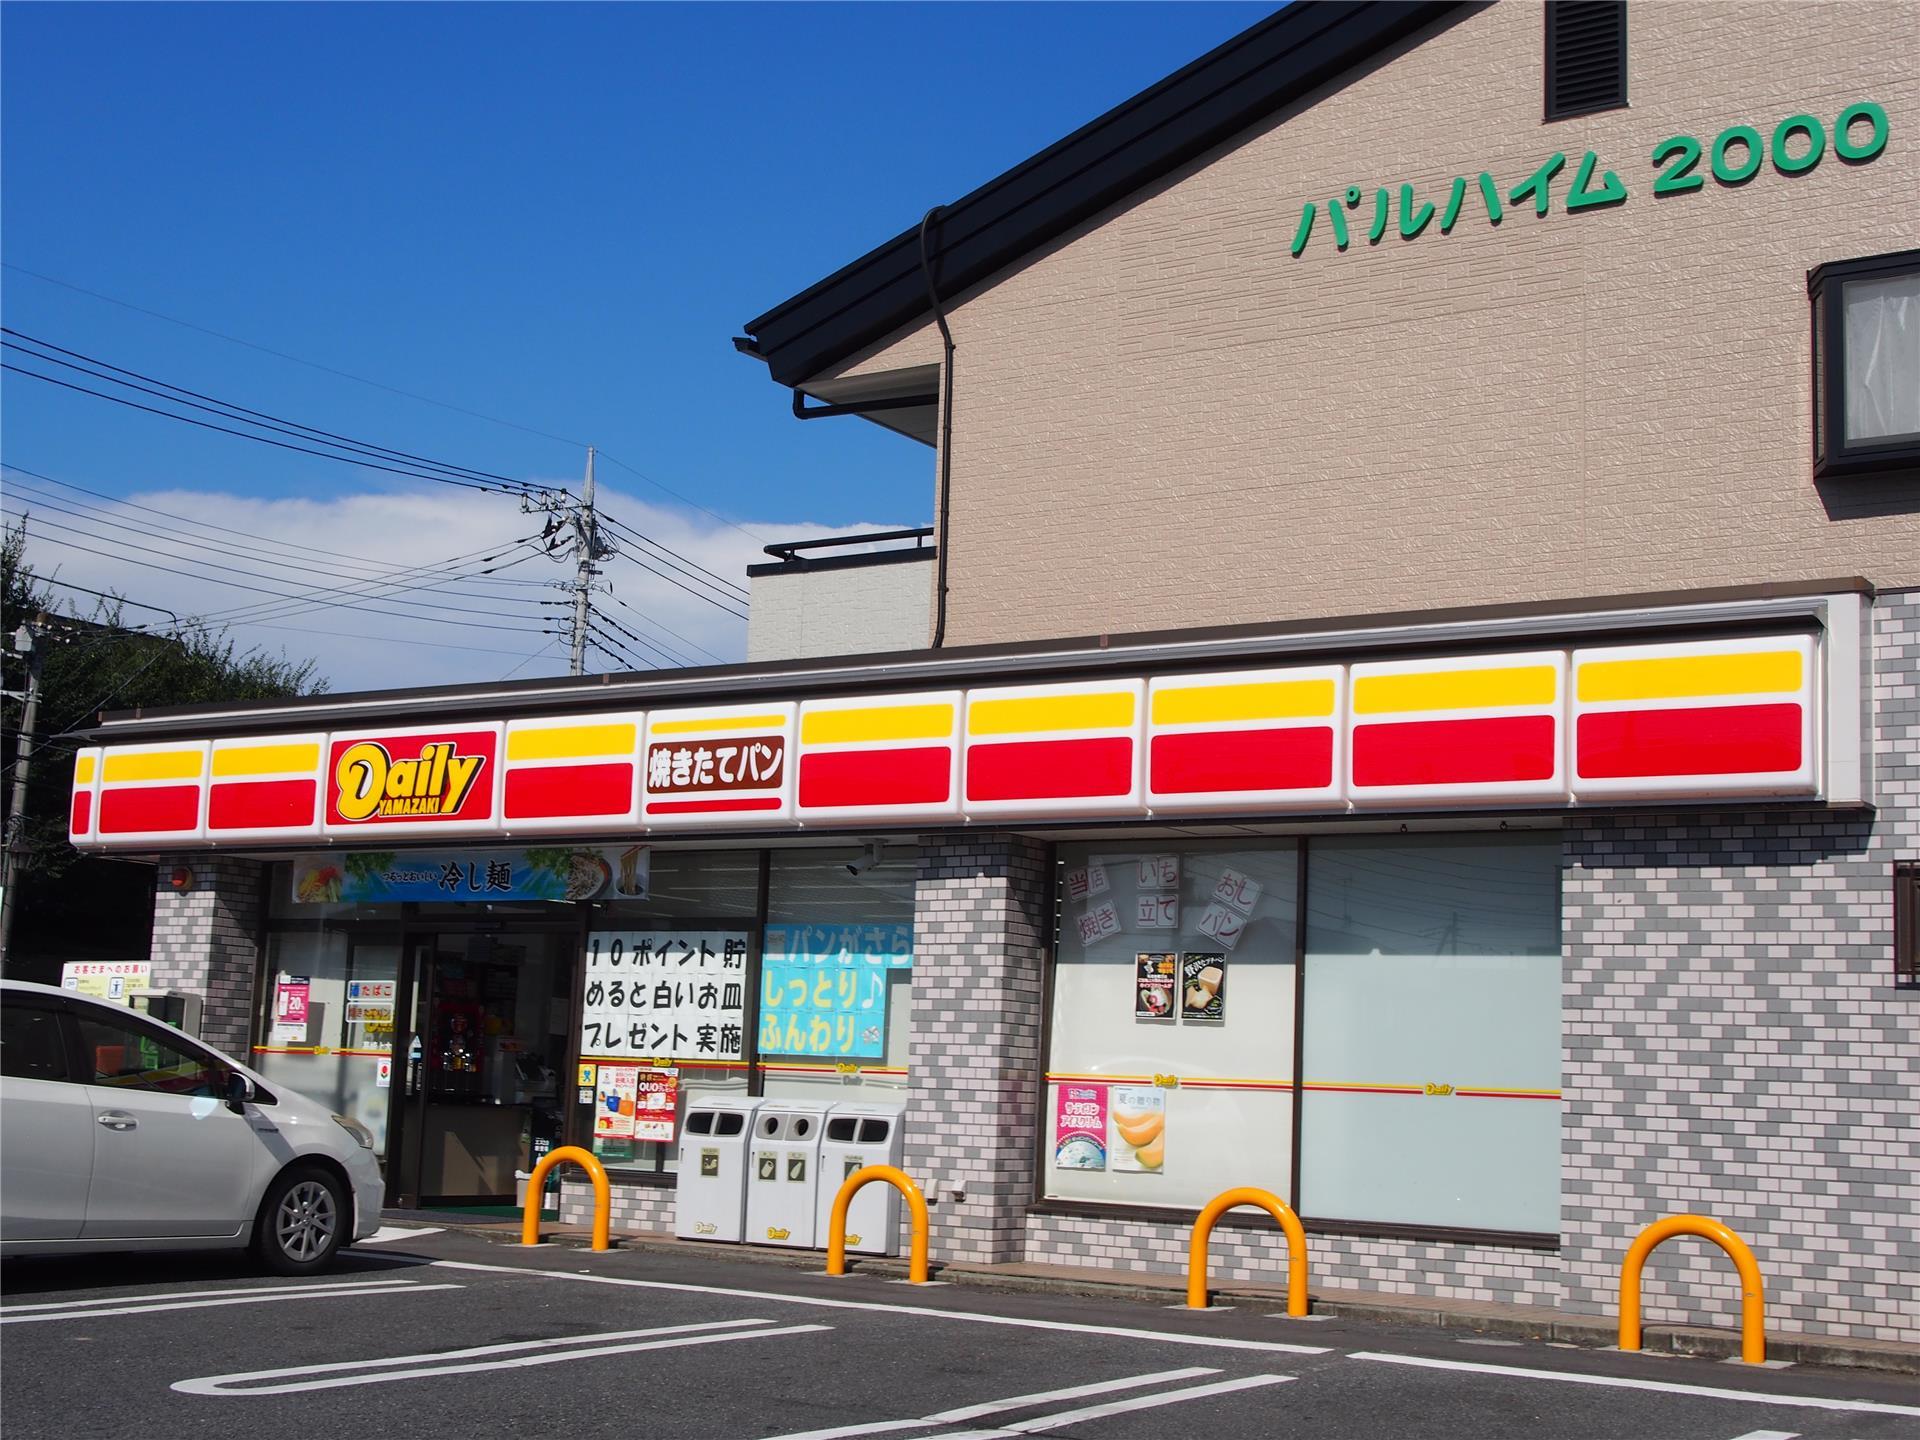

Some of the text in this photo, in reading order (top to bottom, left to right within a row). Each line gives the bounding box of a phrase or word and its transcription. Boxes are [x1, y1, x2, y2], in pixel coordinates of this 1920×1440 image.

[1291, 101, 1889, 256] パルハイム 2000
[337, 742, 485, 819] Daily
[648, 742, 783, 788] 焼きたてパン
[379, 798, 440, 816] YAMAZAKI
[438, 860, 513, 892] 冷し麺
[361, 984, 393, 996] たばこ
[586, 980, 742, 1011] めると白いお皿
[584, 1022, 742, 1054] プレゼント実施
